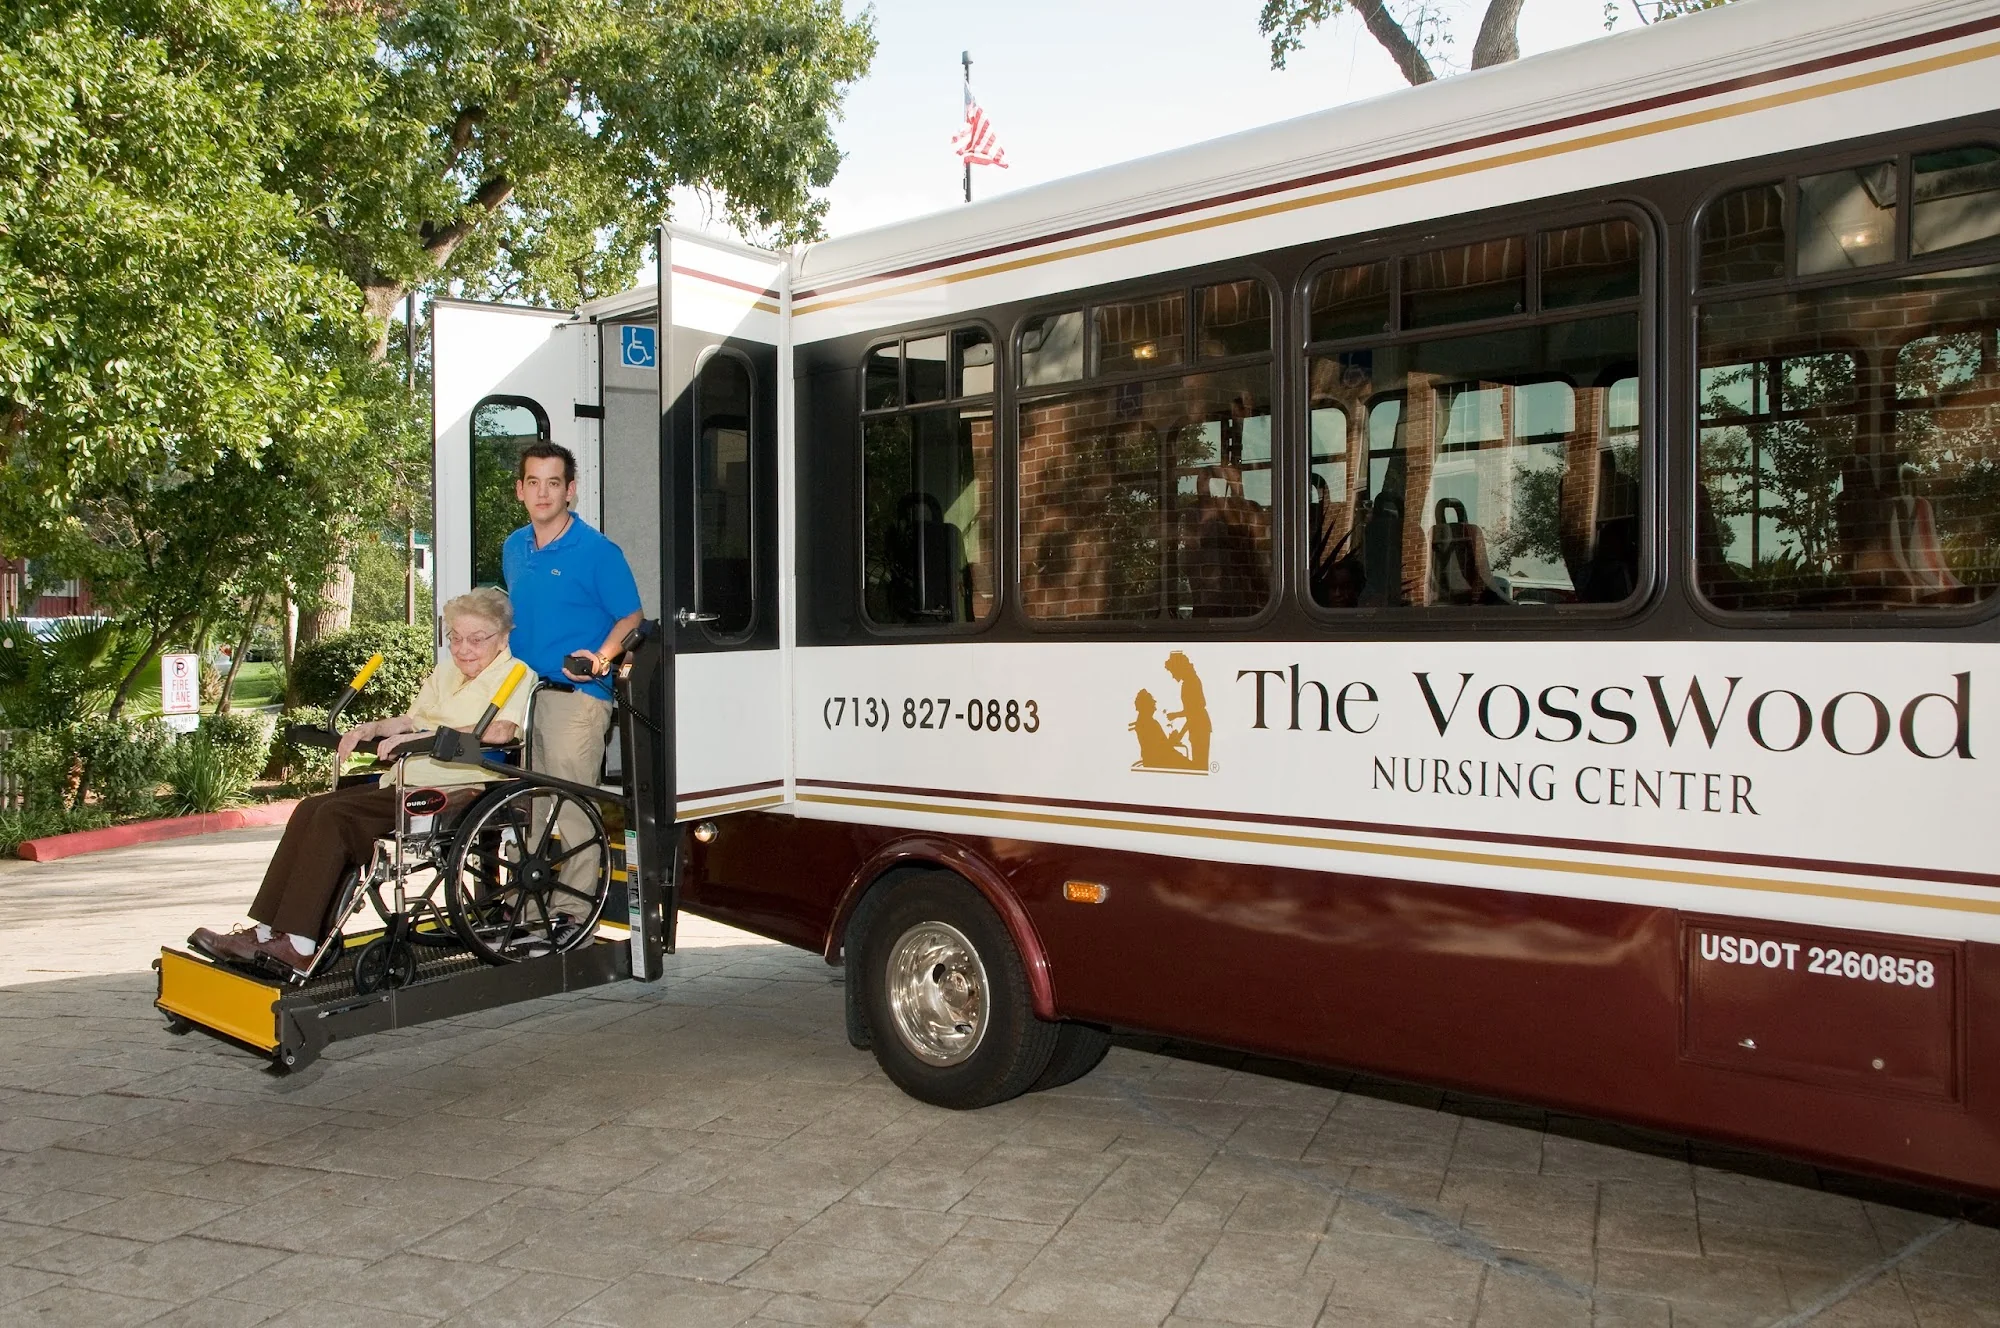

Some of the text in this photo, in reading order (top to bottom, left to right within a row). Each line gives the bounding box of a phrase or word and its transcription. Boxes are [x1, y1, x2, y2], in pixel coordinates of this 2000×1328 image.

[171, 691, 191, 703] LANE
[172, 679, 189, 691] FIRE
[823, 697, 1040, 734] (713) 827-0883
[1236, 663, 1977, 760] The VossWood
[1373, 755, 1761, 816] NURSING CENTER
[1700, 933, 1935, 988] USDOT 2260858
